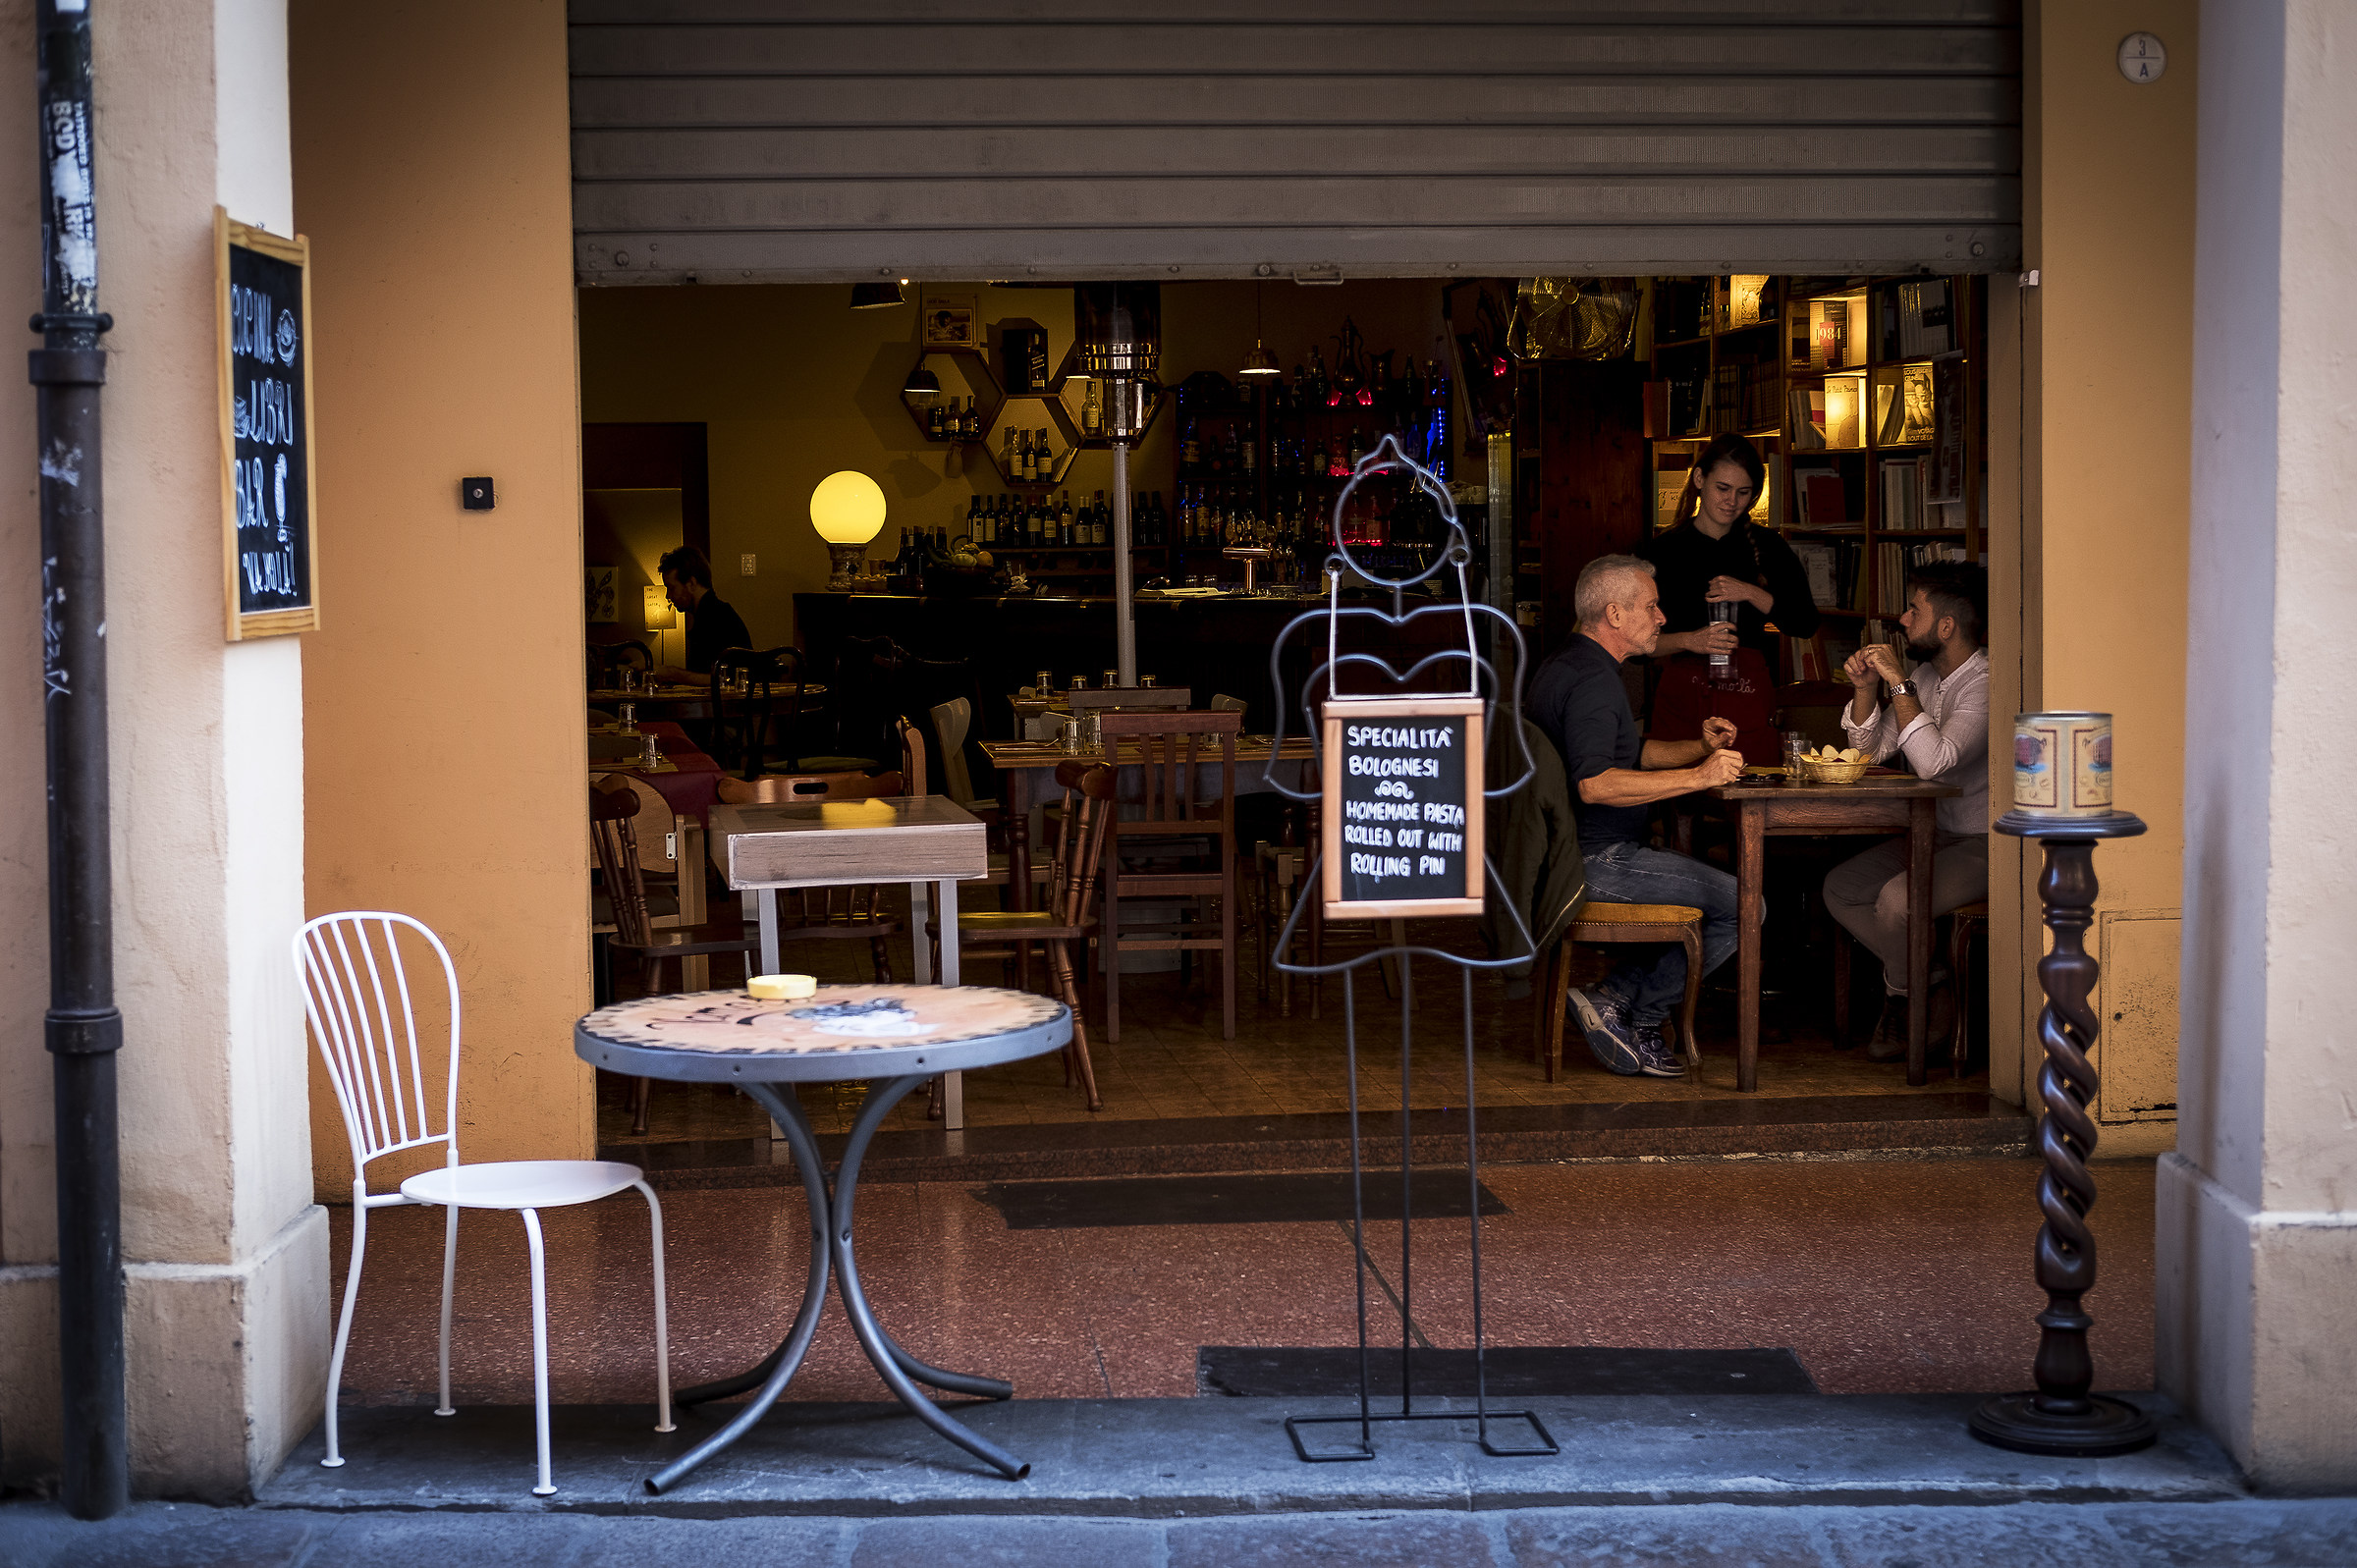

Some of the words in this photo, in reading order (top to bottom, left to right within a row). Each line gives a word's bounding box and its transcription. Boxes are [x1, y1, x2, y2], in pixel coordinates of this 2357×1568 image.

[2139, 63, 2149, 77] A
[1816, 326, 1841, 341] 1984
[249, 378, 294, 446] LIBRI
[234, 456, 269, 529] BAR
[1347, 726, 1454, 749] SPECIALITÀ
[1348, 754, 1439, 778] BOLOGNESI
[1345, 800, 1420, 822] HOMEMADE
[1424, 802, 1465, 827] PASTA
[1344, 825, 1393, 847] ROLLED
[1397, 829, 1424, 848] OUT
[1428, 832, 1463, 852] WITH
[1350, 852, 1411, 877] ROLLING
[1419, 855, 1446, 876] PIN
